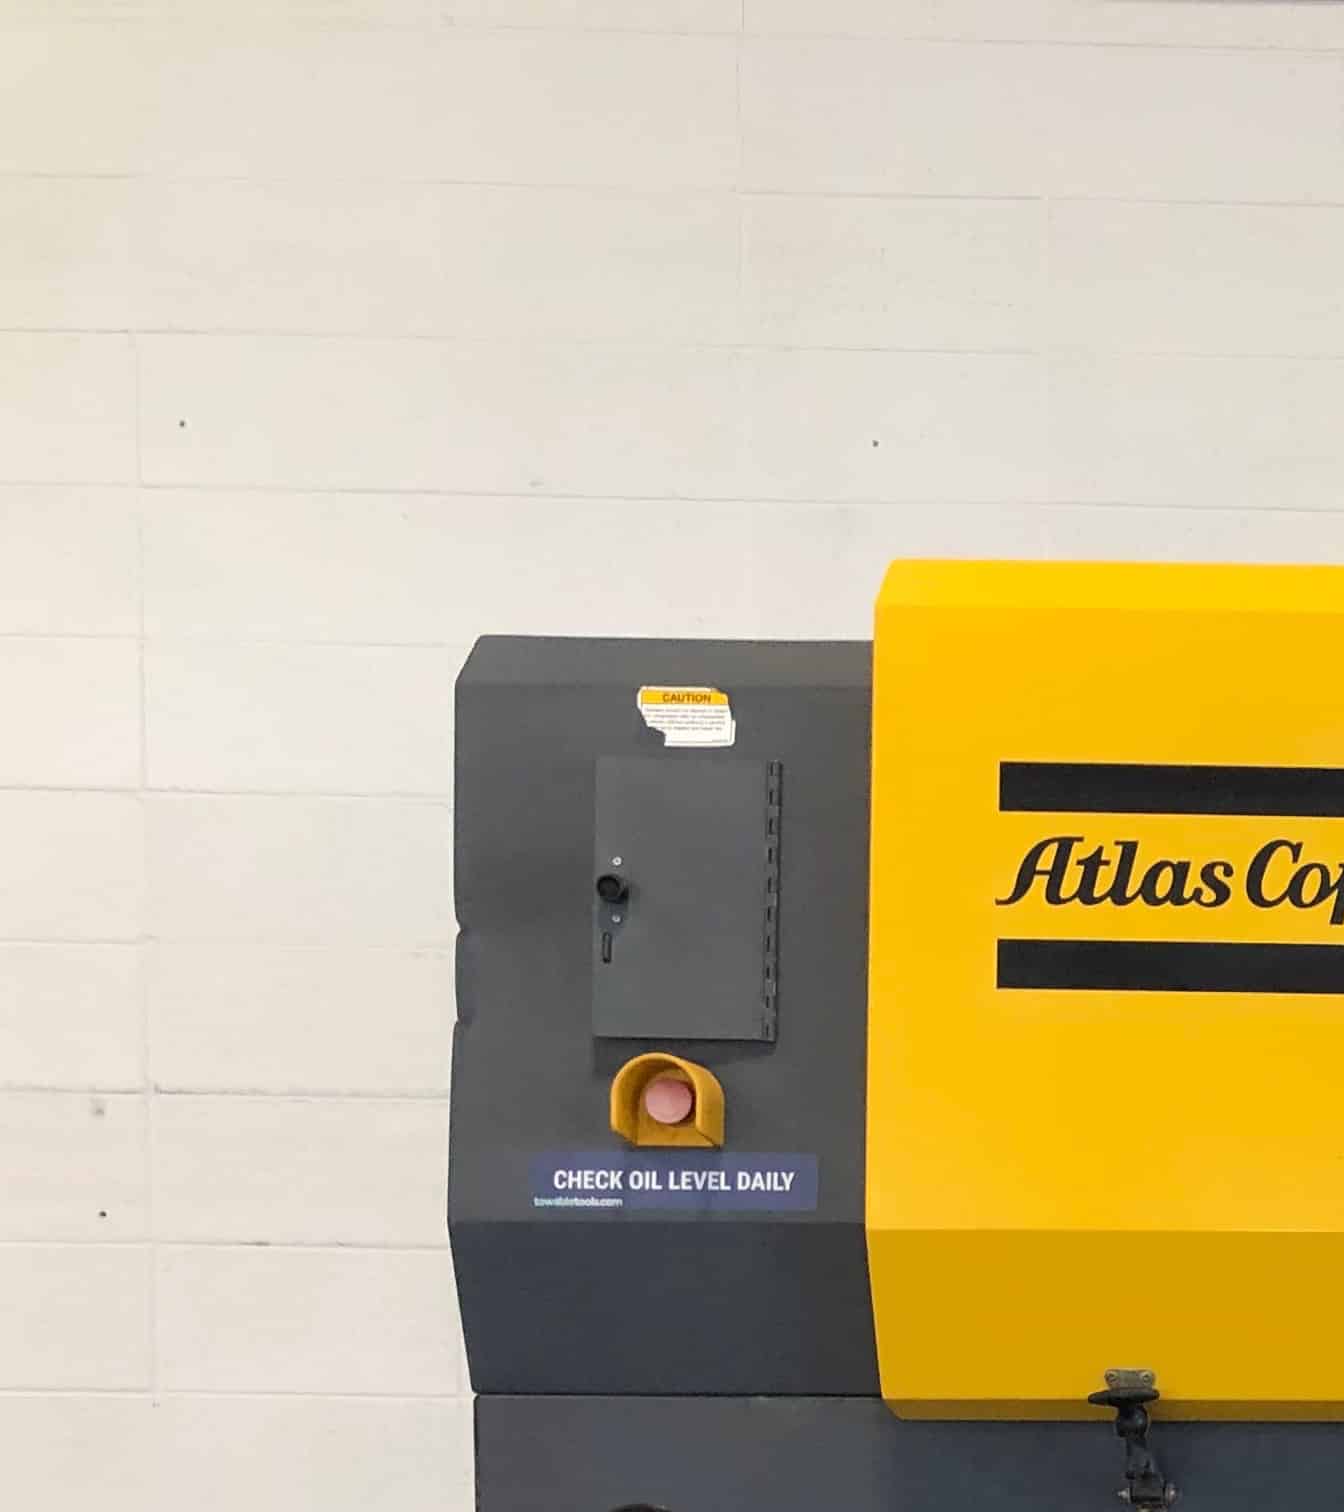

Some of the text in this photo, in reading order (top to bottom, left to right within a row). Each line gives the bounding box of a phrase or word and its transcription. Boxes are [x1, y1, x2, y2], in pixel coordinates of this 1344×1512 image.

[661, 693, 712, 702] CAUTION
[994, 836, 1233, 908] Atlas
[553, 1169, 795, 1192] CHECK OIL LEVEL DAILY
